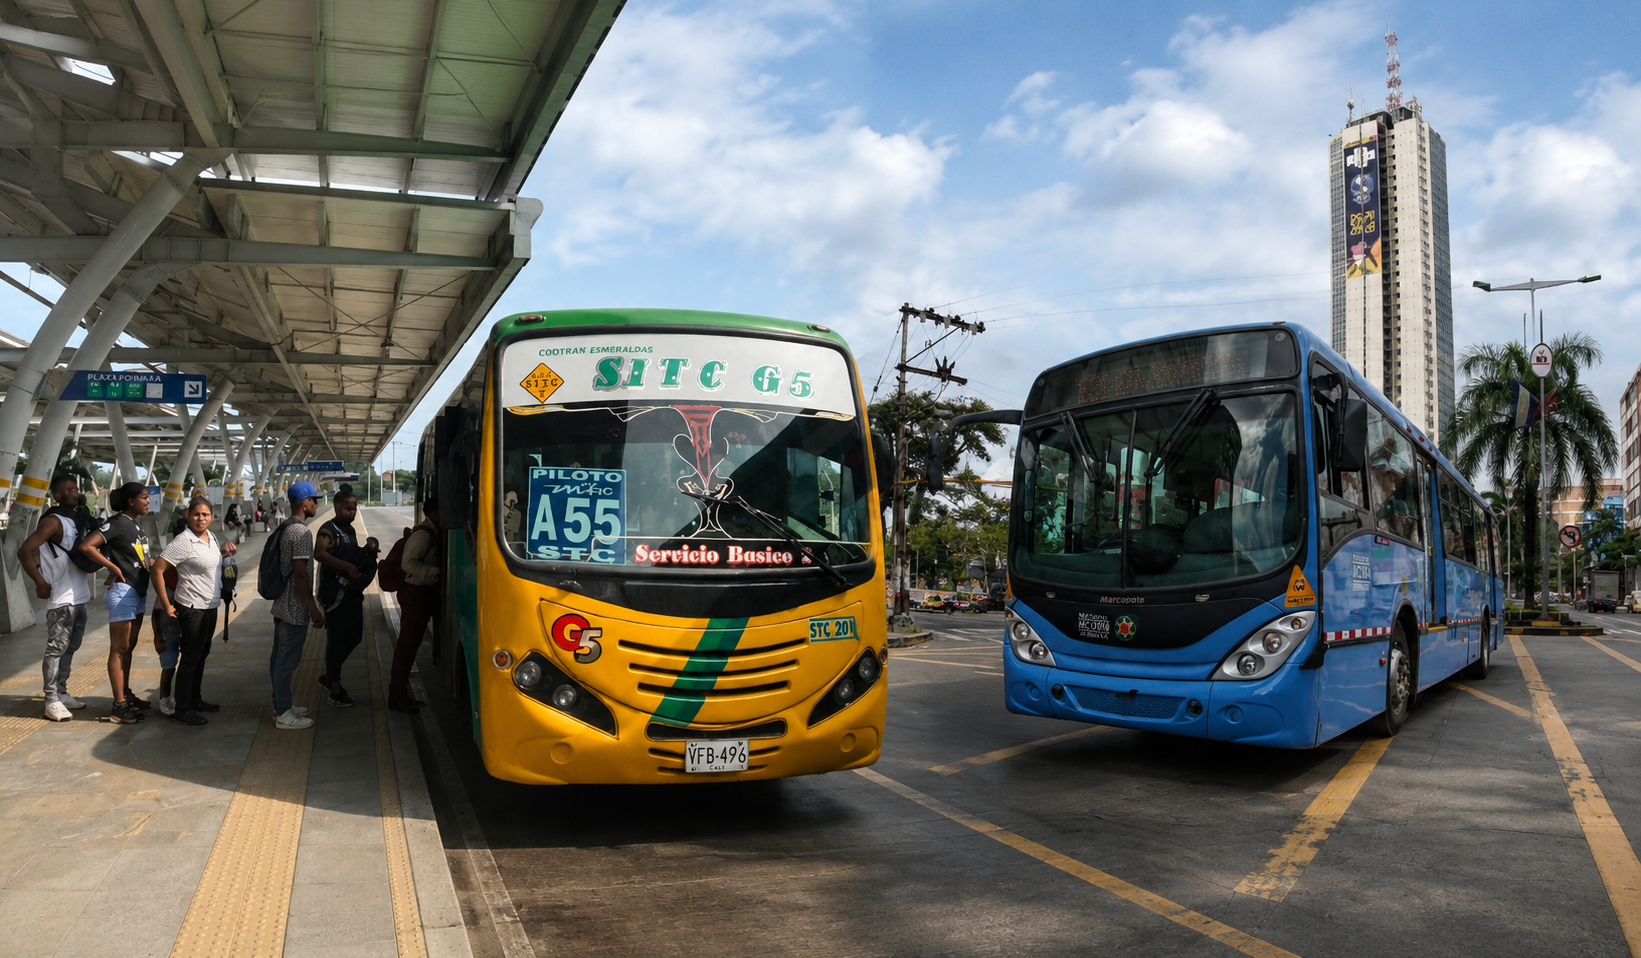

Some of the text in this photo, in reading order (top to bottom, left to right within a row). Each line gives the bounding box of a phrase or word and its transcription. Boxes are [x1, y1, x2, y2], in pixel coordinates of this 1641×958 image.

[589, 346, 653, 354] ESMERALDAS
[592, 355, 817, 400] SITC G5
[533, 469, 623, 483] PILOTO
[537, 545, 616, 564] STC
[634, 543, 720, 565] Servicio
[726, 545, 794, 566] Basico
[1100, 595, 1145, 605] Marcopolo
[551, 612, 603, 665] G5
[810, 621, 831, 638] STC
[688, 746, 746, 765] VFB-496
